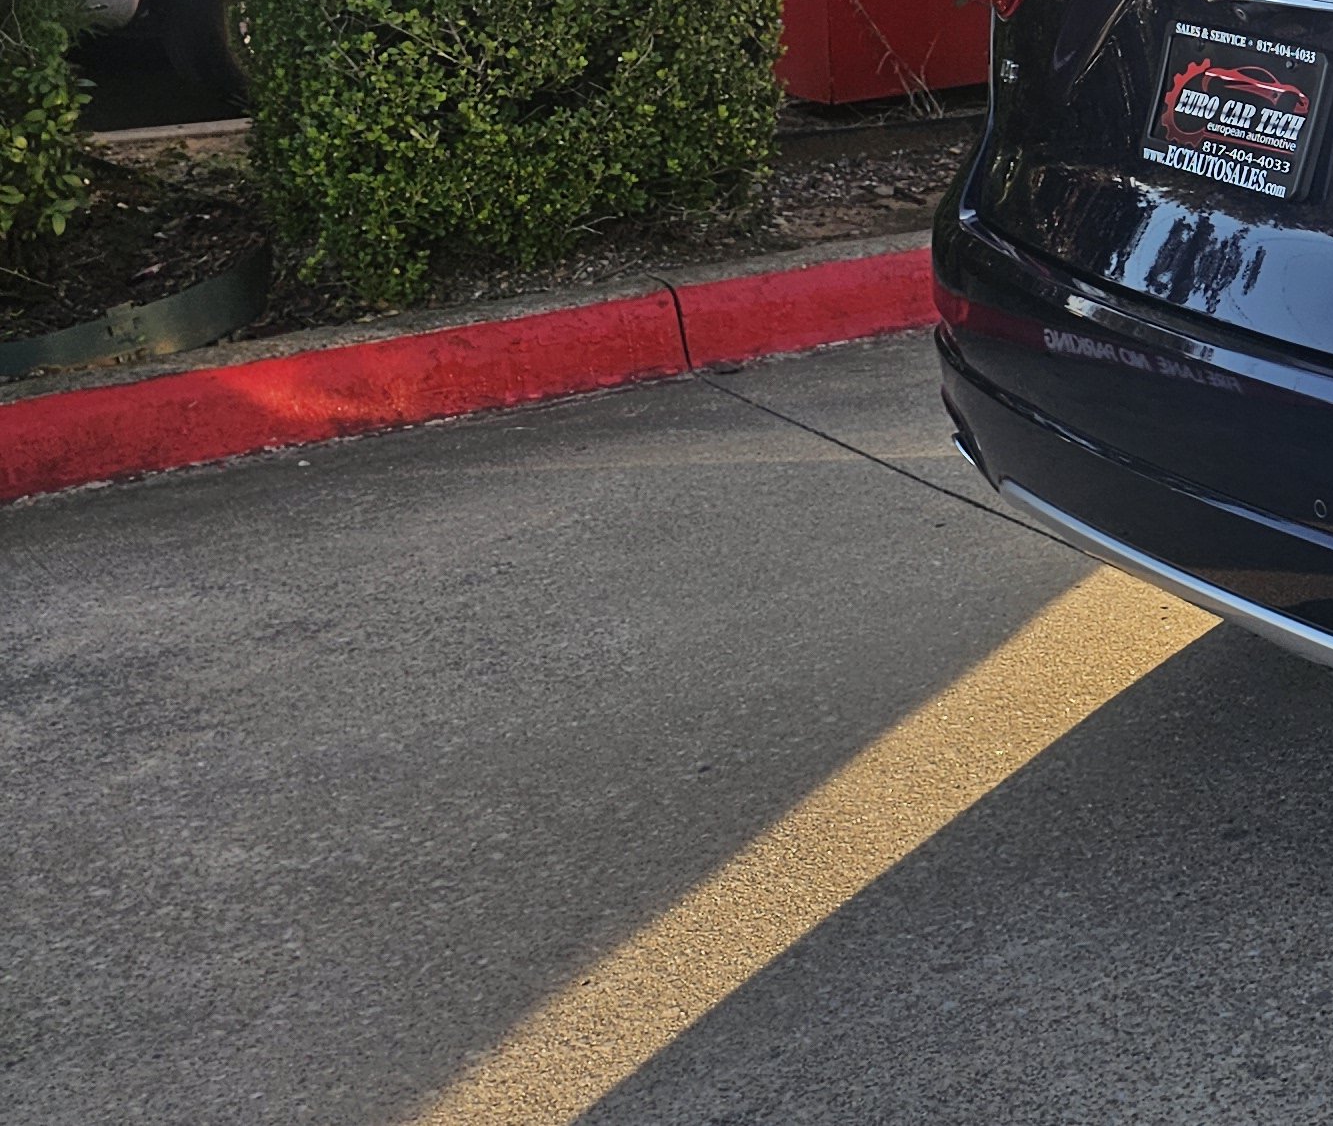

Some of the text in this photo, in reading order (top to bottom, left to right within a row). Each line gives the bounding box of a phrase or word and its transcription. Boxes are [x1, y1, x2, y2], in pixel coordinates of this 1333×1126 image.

[1175, 22, 1316, 64] SALES & SERVICE 817-404-4033
[1174, 88, 1306, 141] EURO CAR TECH
[1202, 140, 1291, 174] 817-404-4033
[1206, 121, 1297, 152] european automotive
[1143, 144, 1287, 199] www.ECTAUTOSALES.com
